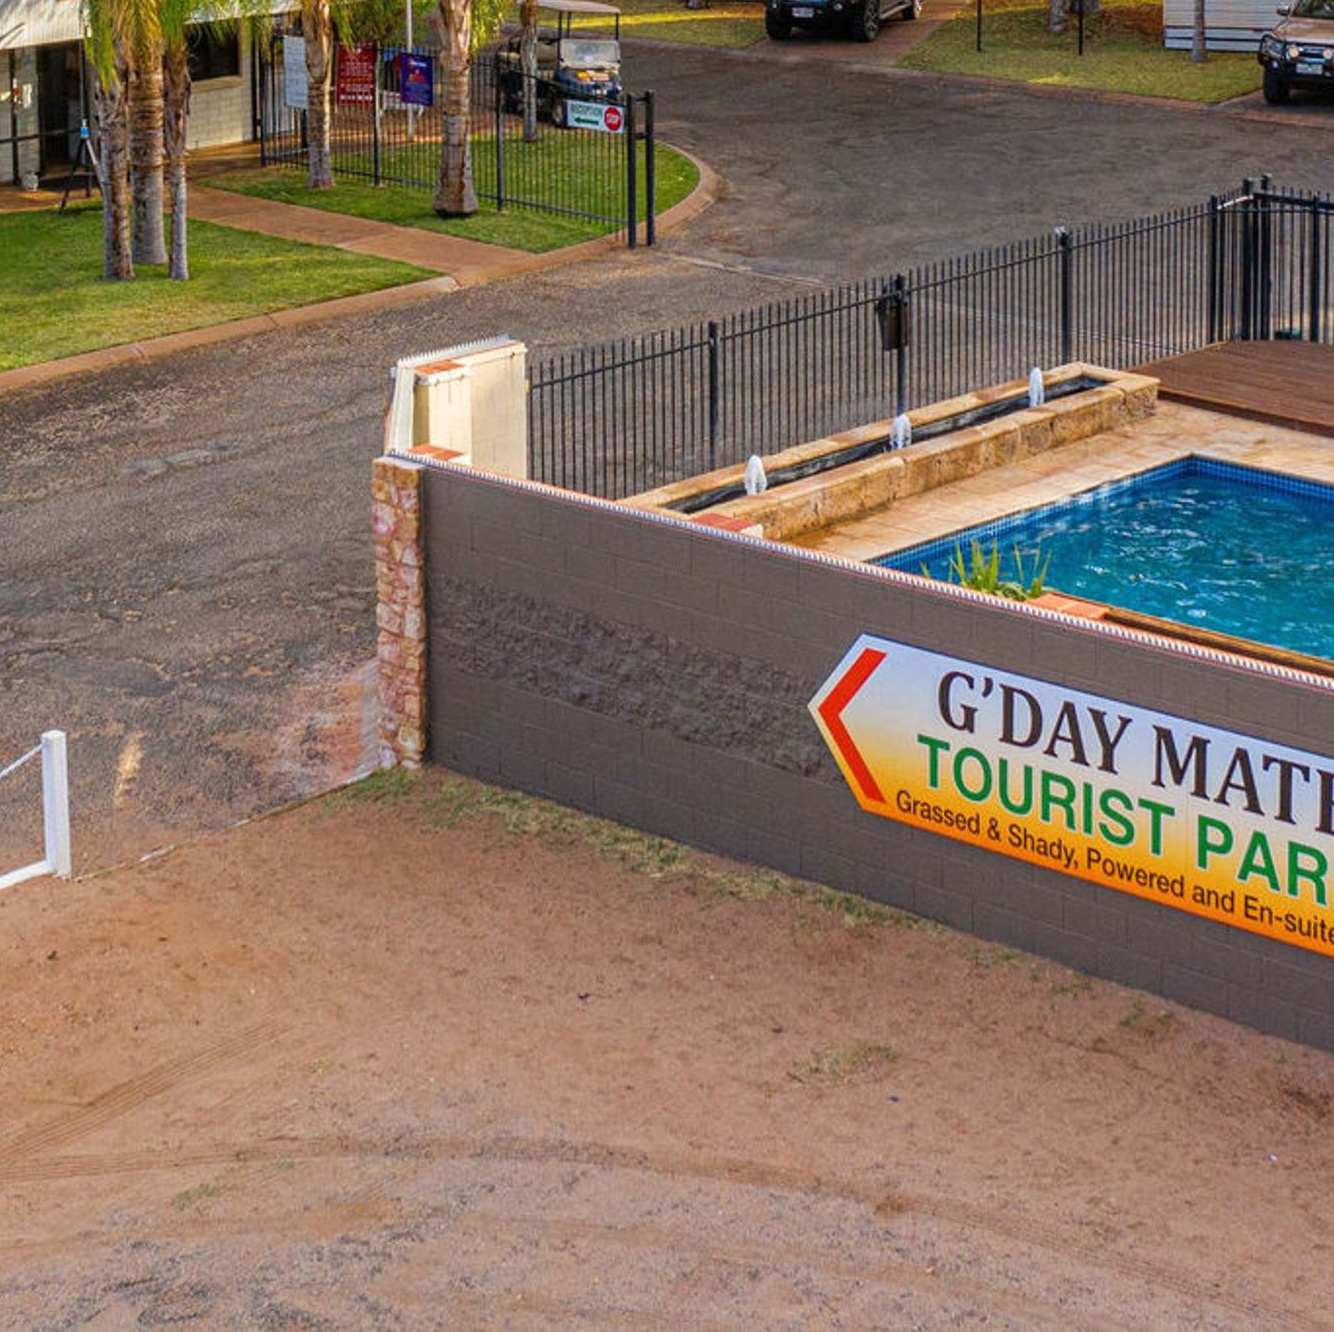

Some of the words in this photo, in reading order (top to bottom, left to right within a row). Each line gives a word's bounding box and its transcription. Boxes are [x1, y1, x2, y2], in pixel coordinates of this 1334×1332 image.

[938, 671, 1133, 775] G'DAY
[896, 789, 980, 835] Grassed
[987, 817, 1001, 842] &
[1008, 824, 1079, 869] Shady,
[1087, 848, 1184, 898] Powered
[1192, 885, 1234, 913] and
[917, 733, 1175, 857] TOURIST
